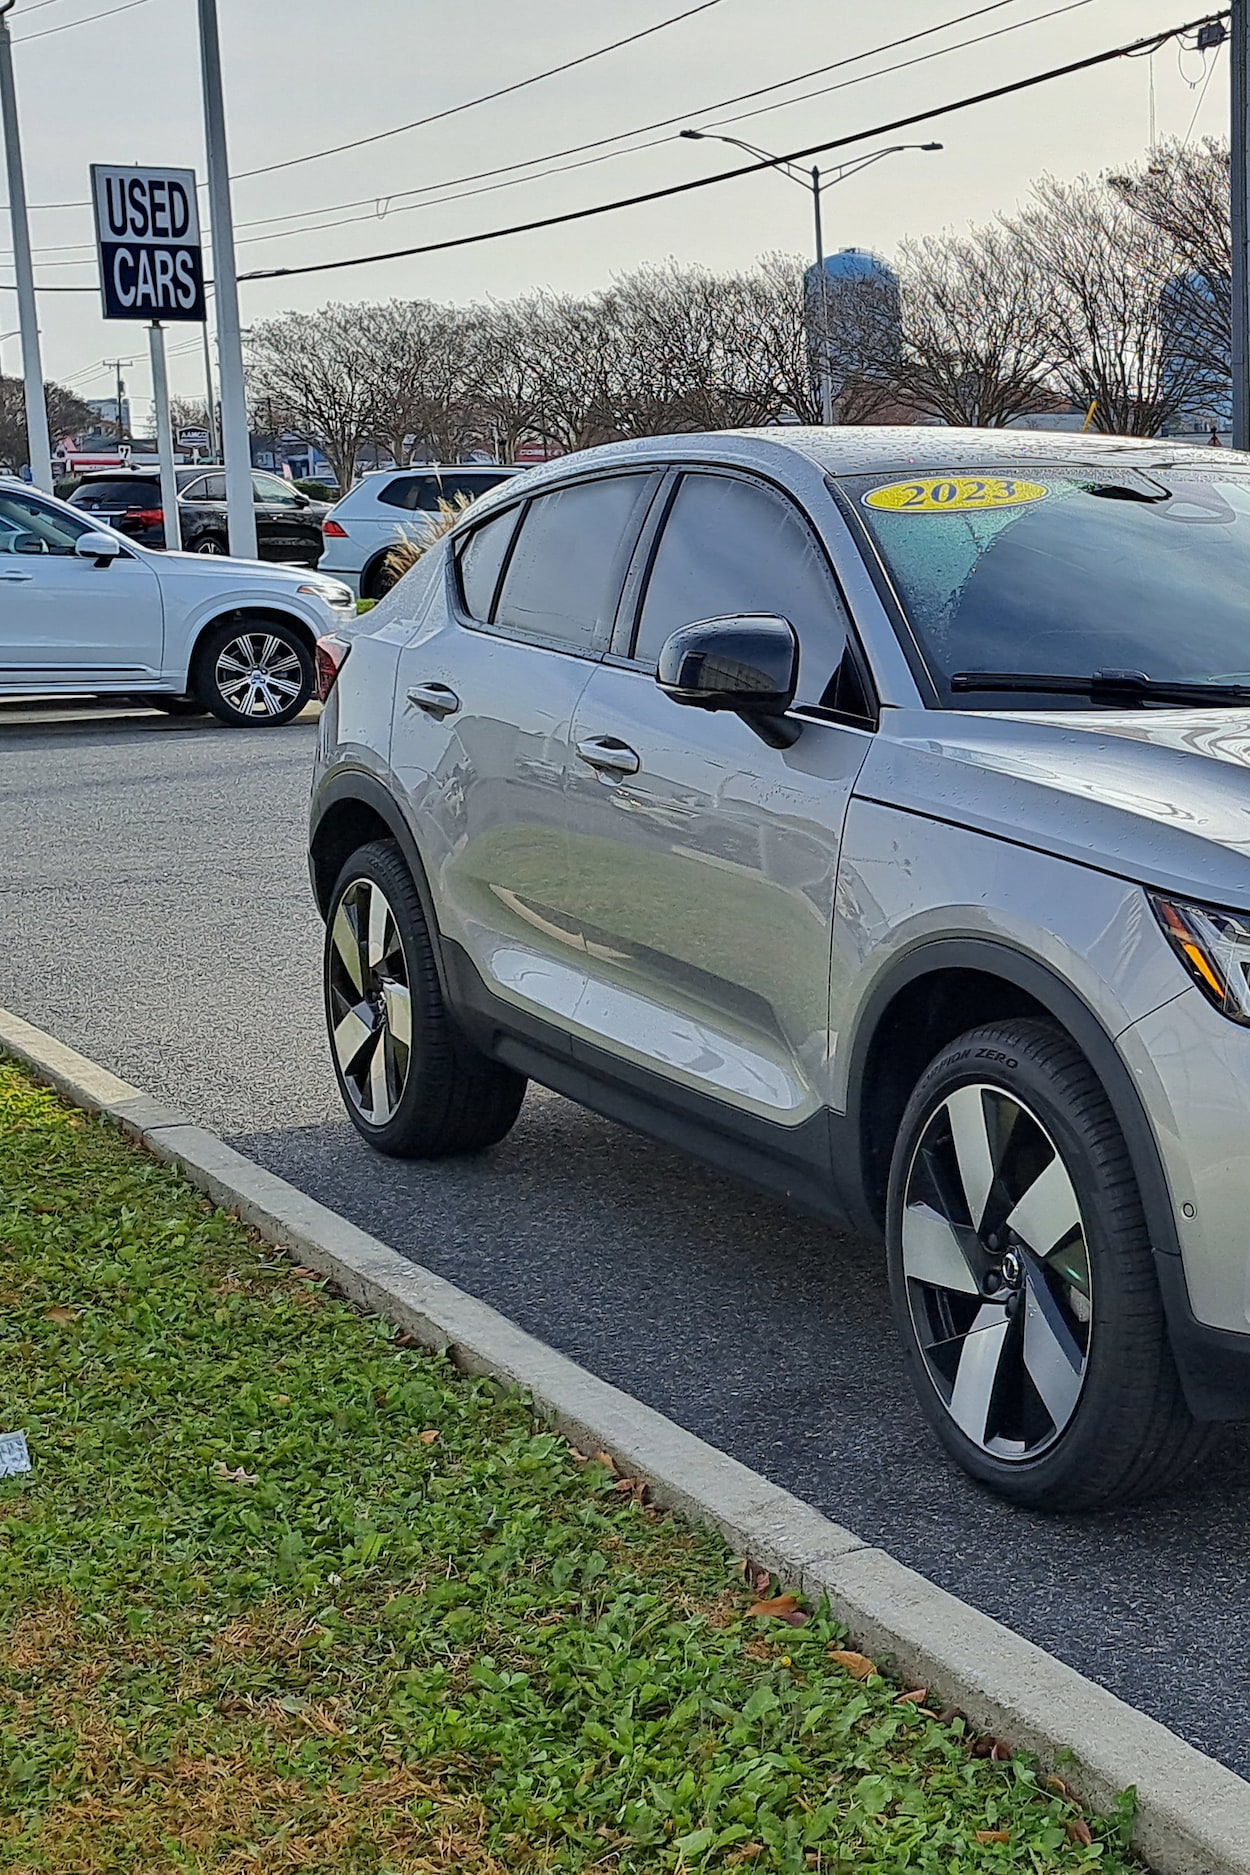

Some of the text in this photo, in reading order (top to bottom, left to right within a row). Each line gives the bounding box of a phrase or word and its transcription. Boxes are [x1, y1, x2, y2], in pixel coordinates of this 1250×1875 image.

[105, 177, 190, 238] USED
[113, 247, 197, 309] CARS
[900, 480, 1016, 507] 2023
[974, 1047, 1019, 1069] ZERO
